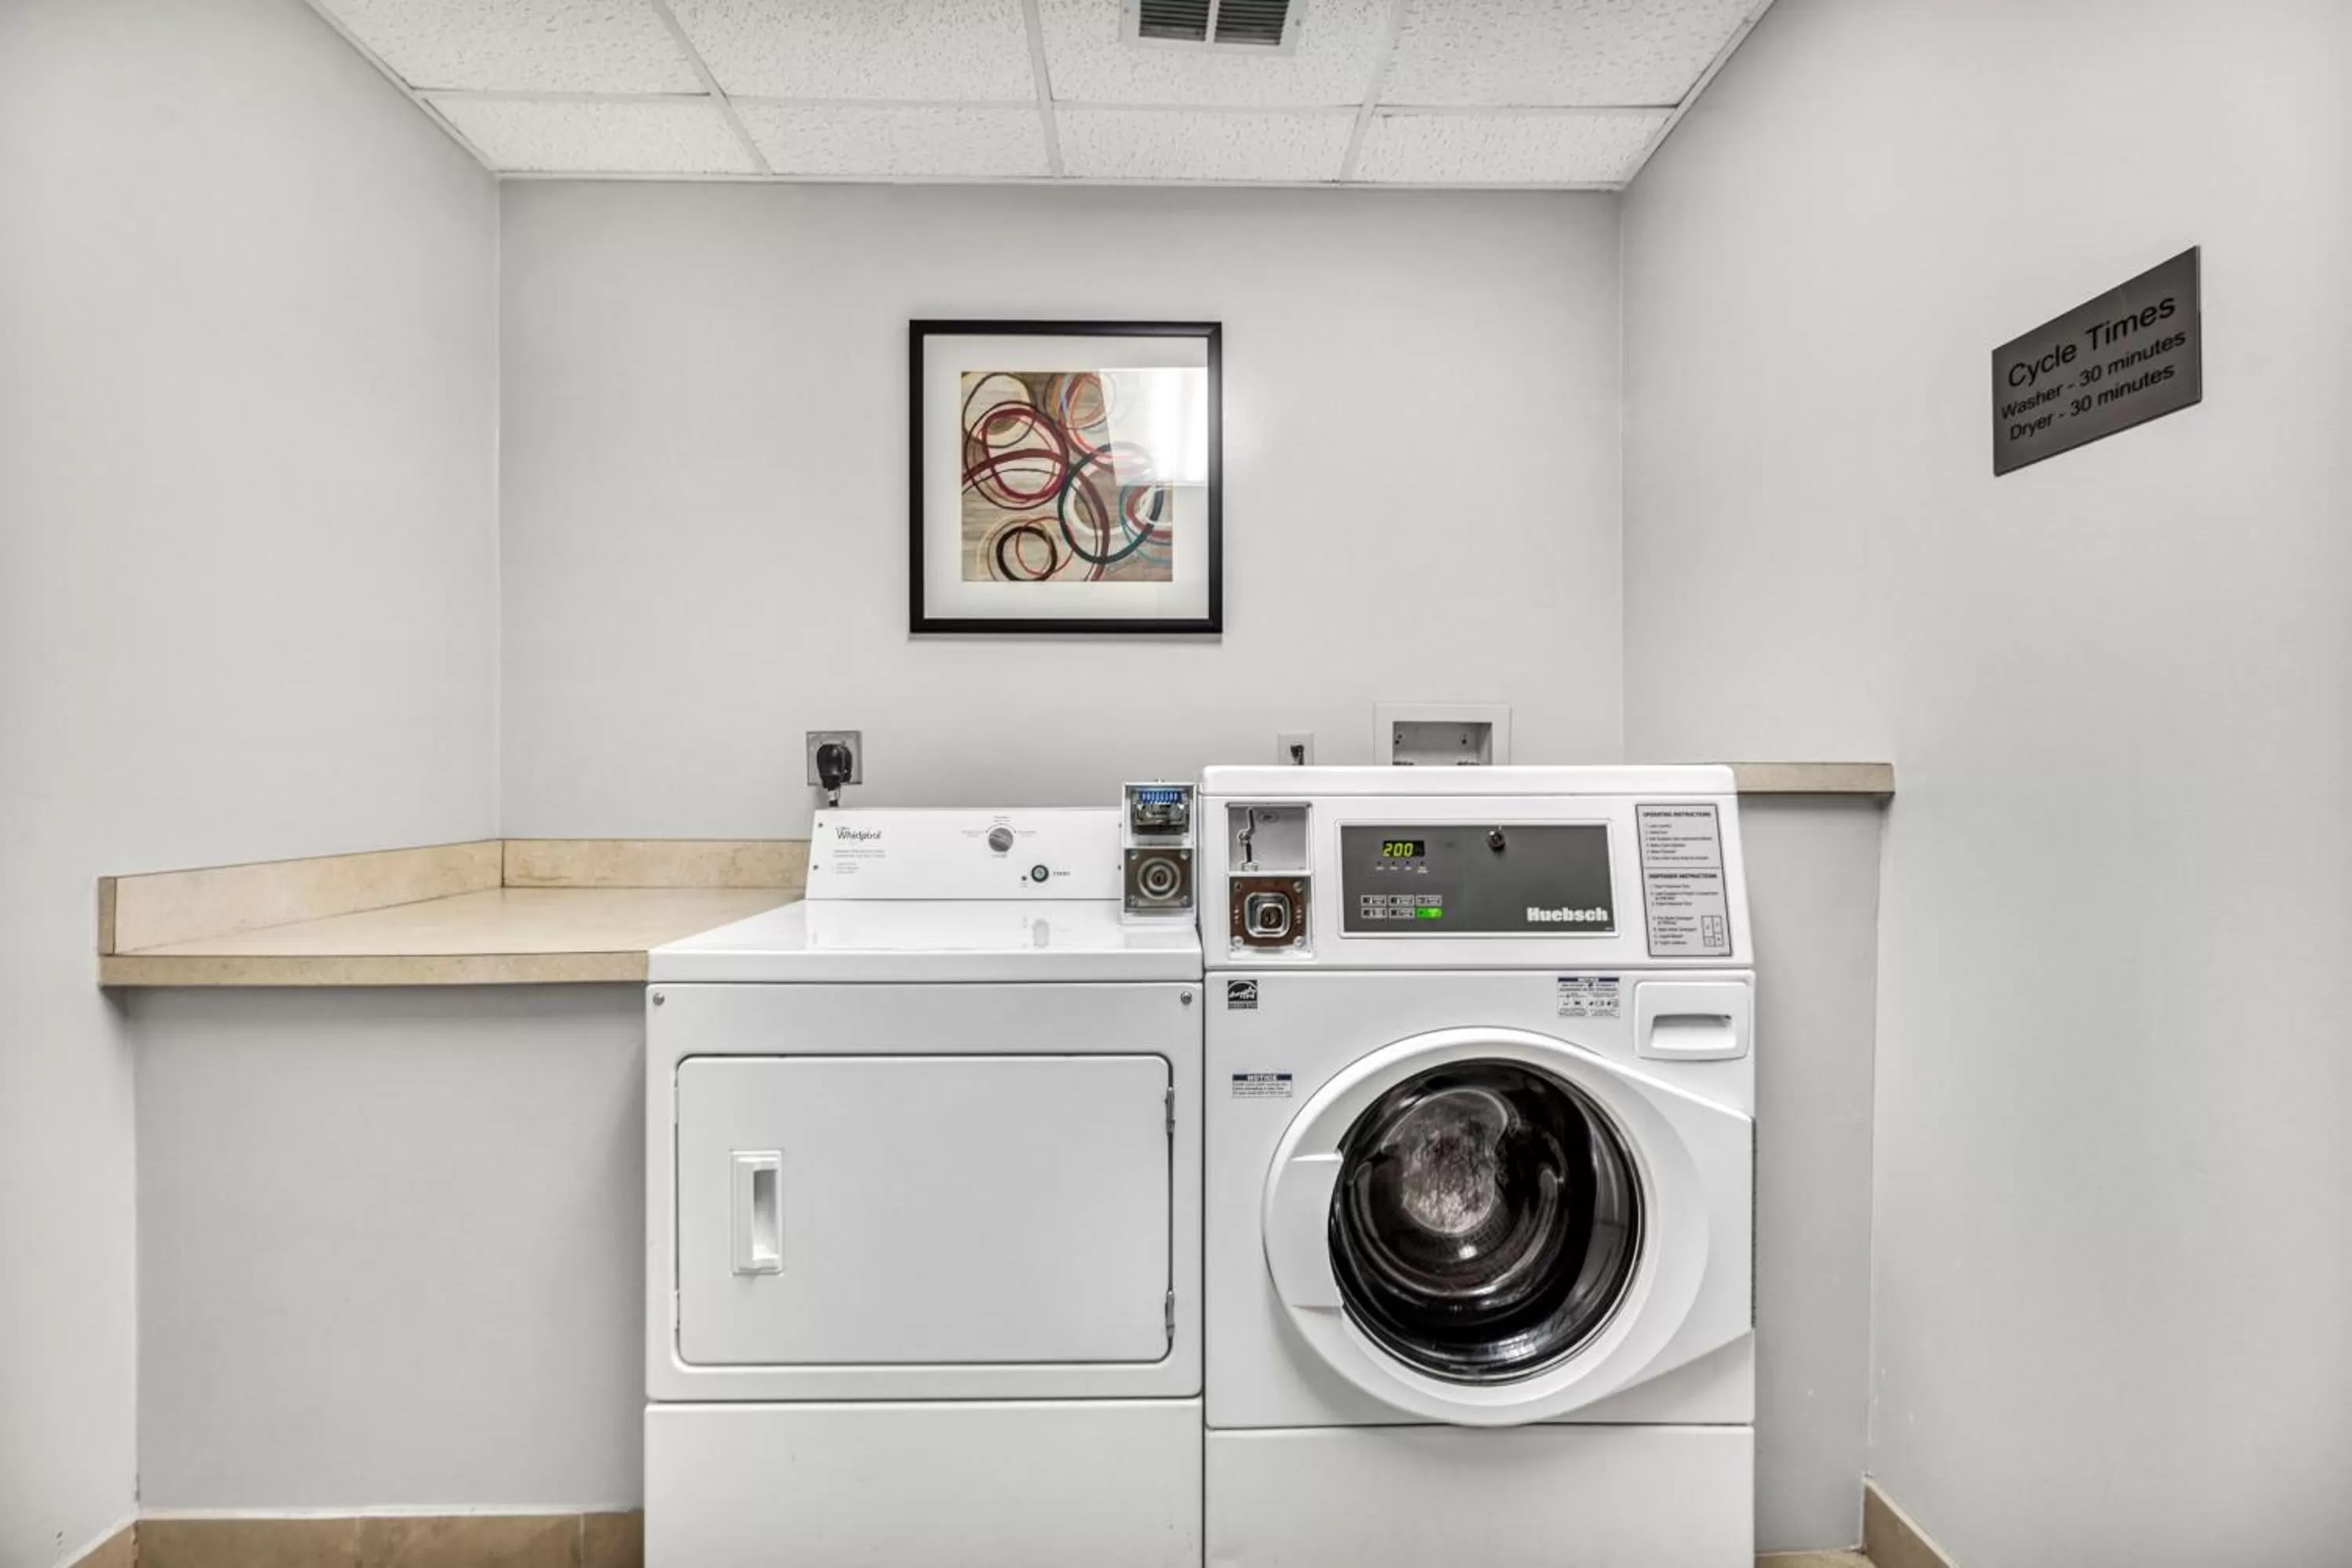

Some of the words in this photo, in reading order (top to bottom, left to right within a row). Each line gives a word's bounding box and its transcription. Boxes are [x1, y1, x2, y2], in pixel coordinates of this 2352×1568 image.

[2002, 383, 2063, 419] Washer
[2079, 365, 2102, 387] 30
[2107, 330, 2187, 376] minutes
[2008, 342, 2077, 387] Cycle
[2085, 296, 2176, 350] Times
[2009, 412, 2053, 441] Dryer
[2070, 394, 2092, 417] 30
[2097, 363, 2176, 406] minutes
[1382, 843, 1414, 857] 200
[1526, 906, 1608, 922] Huebsch
